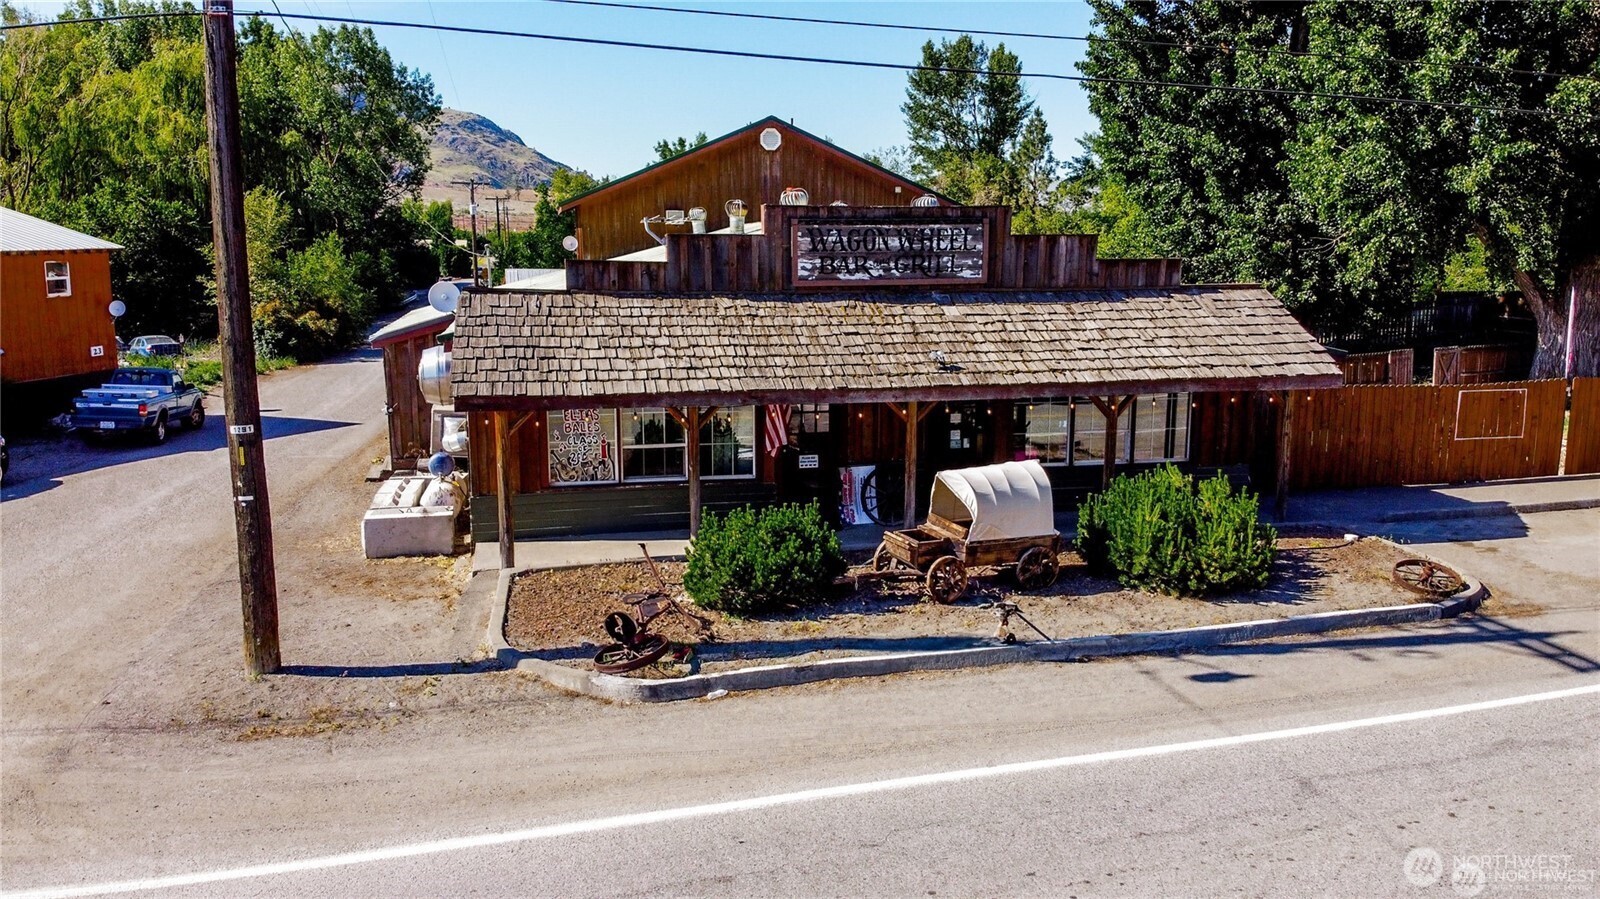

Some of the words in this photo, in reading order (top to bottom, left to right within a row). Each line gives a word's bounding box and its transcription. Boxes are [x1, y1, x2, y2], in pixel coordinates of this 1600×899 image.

[806, 228, 894, 252] WAGON
[898, 226, 977, 252] WHEEL
[819, 255, 879, 277] BAR
[894, 254, 964, 277] GRILL
[93, 347, 102, 355] 23
[564, 422, 600, 433] BALES
[567, 435, 599, 445] CLASS
